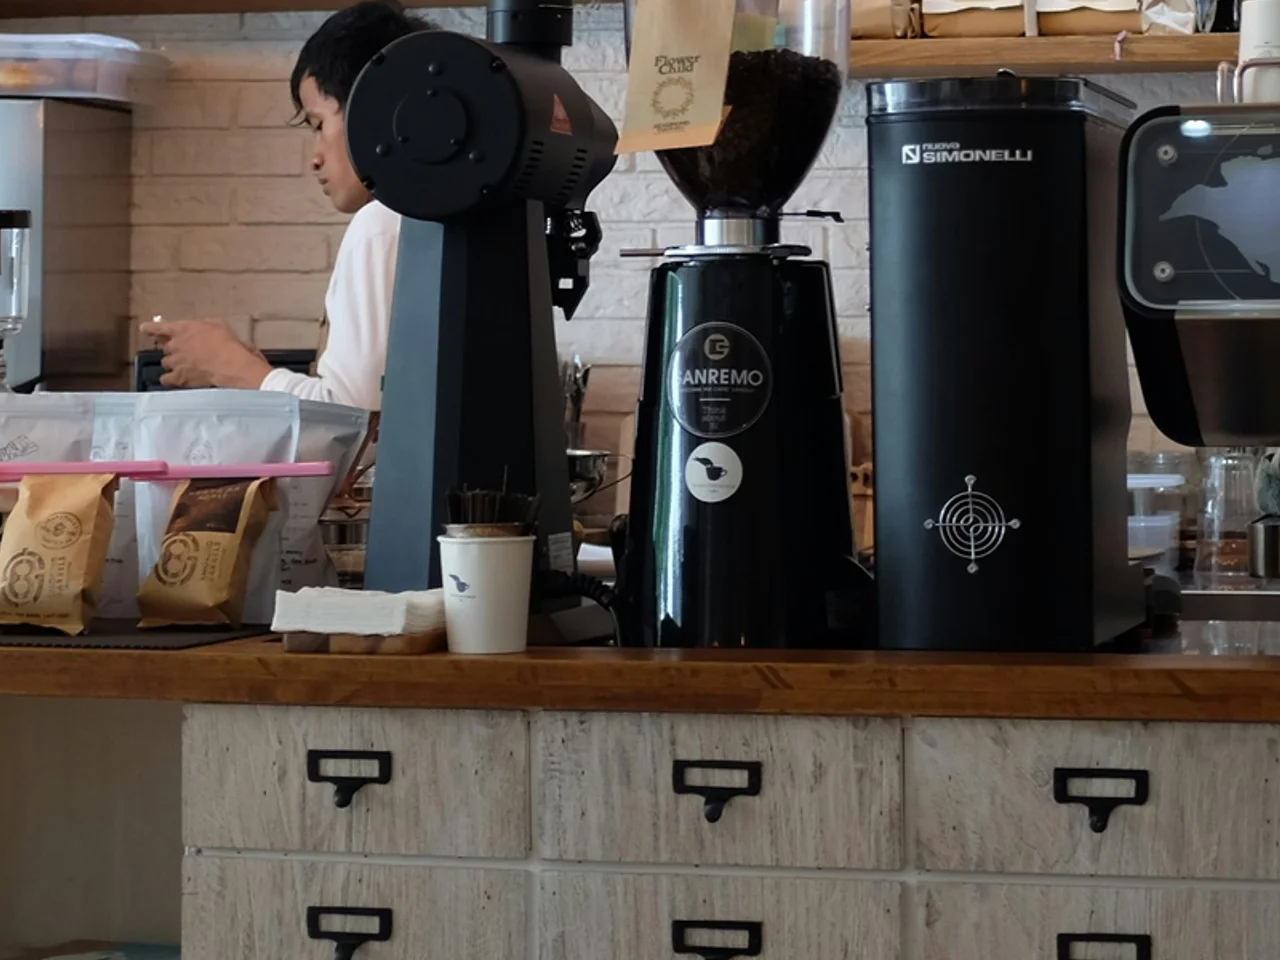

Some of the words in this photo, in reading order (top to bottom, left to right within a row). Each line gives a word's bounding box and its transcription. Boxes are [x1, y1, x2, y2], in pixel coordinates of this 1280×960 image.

[654, 55, 701, 67] Flower
[658, 60, 694, 75] Child
[922, 142, 961, 150] nuova
[922, 149, 1033, 164] SIMONELLI
